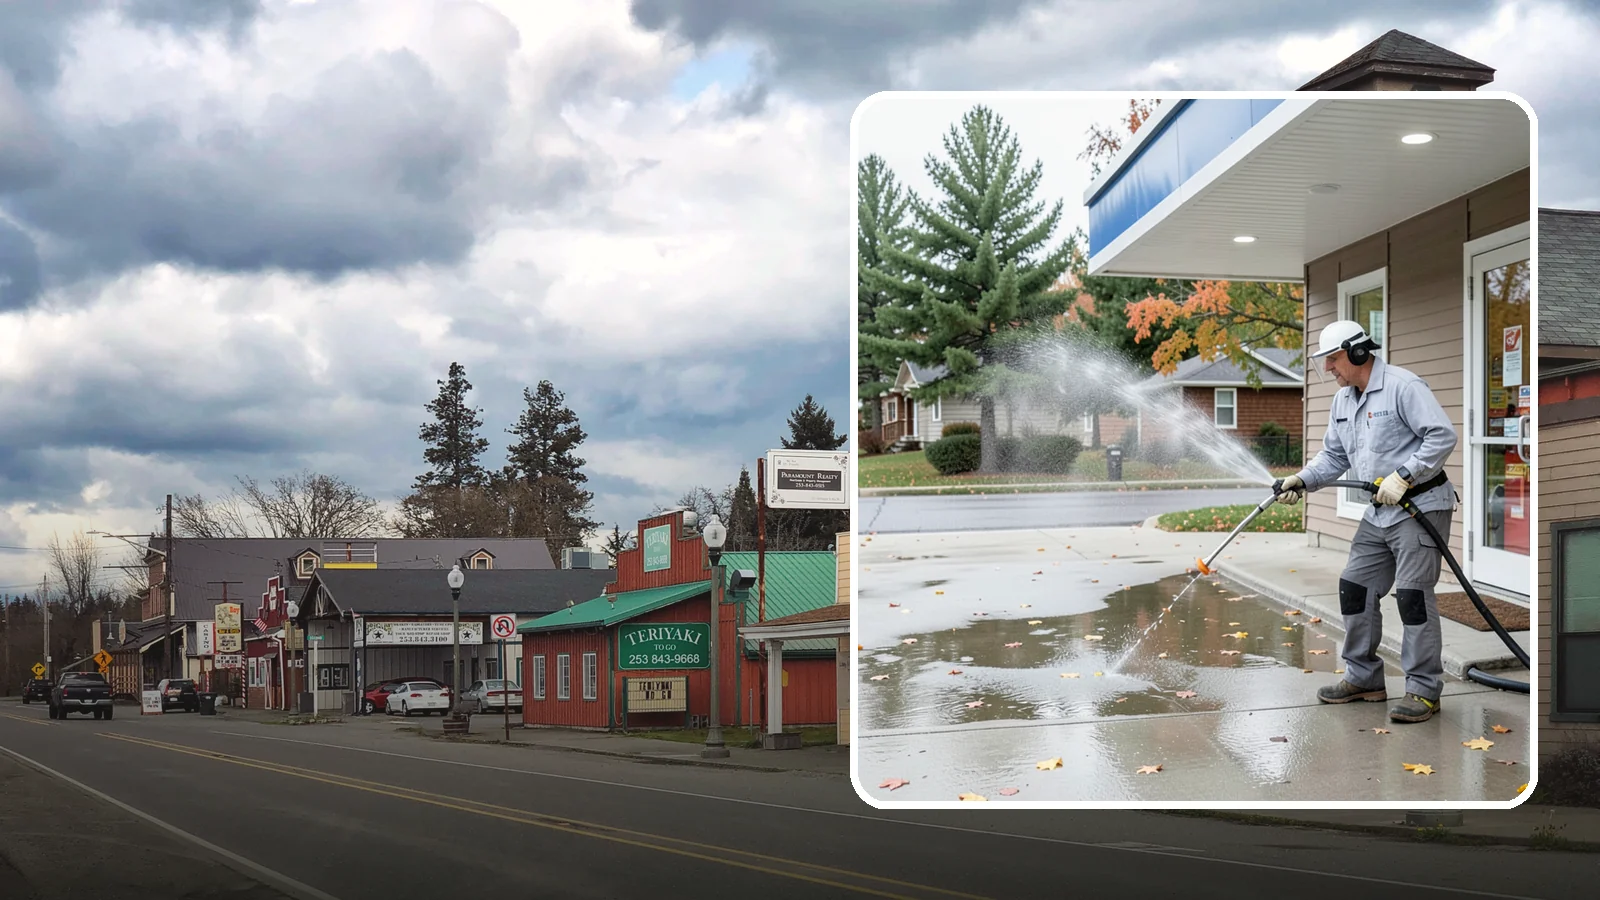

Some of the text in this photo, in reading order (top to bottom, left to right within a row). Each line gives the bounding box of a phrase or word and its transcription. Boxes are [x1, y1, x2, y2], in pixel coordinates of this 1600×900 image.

[646, 531, 668, 549] TERIYAKI
[625, 628, 702, 646] TERIYAKI
[629, 654, 699, 665] 253 843-9668
[639, 681, 672, 691] TERIYAKI
